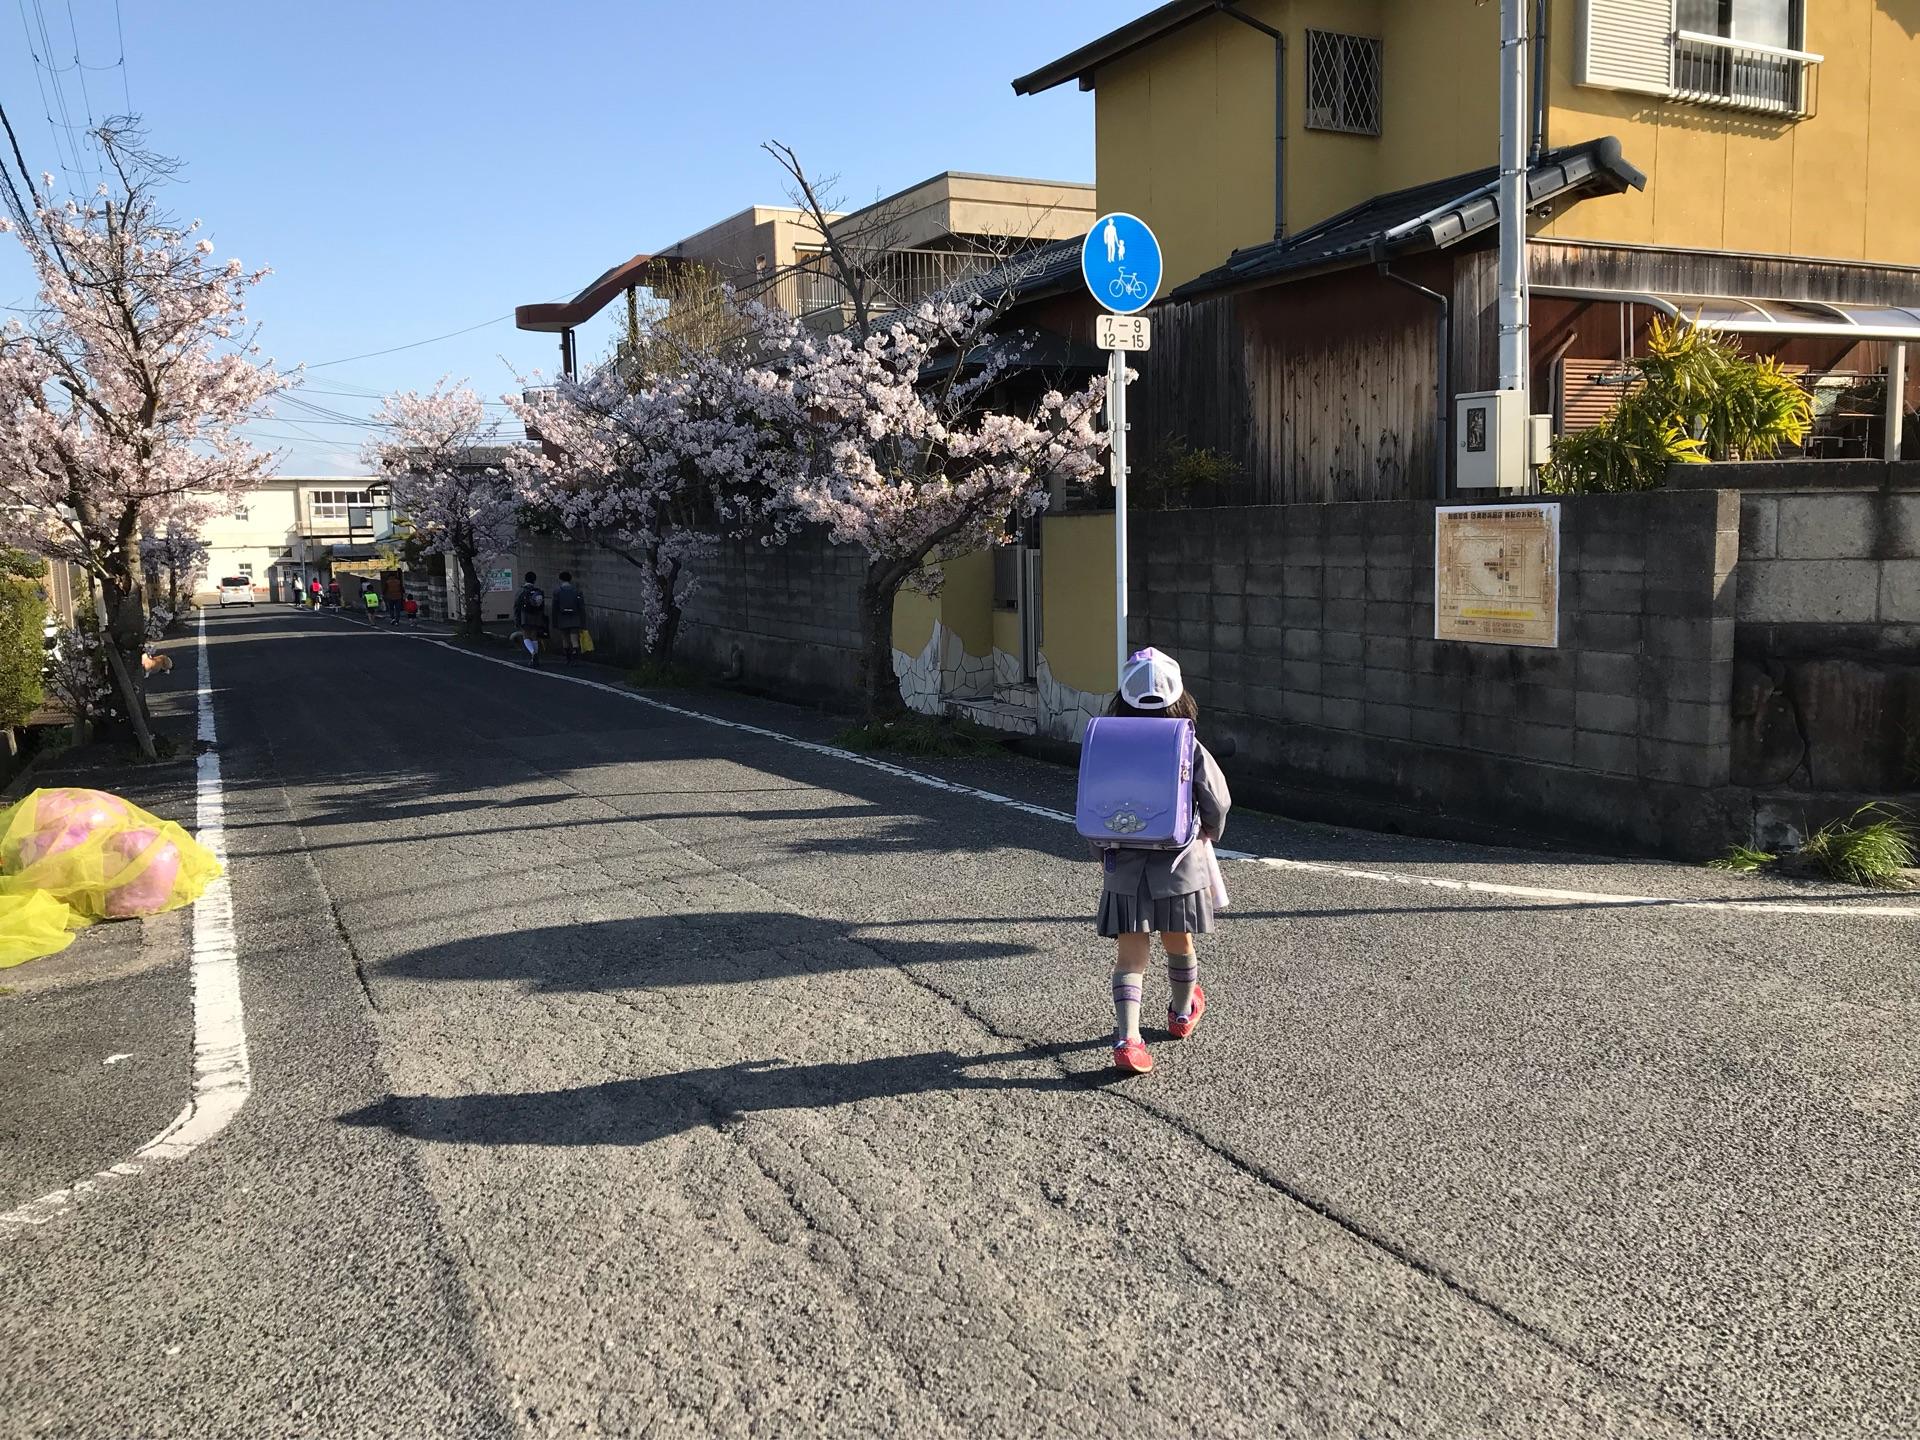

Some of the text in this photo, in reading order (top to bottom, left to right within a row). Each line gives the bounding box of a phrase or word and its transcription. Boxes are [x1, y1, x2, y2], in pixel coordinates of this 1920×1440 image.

[1106, 318, 1113, 332] 7
[1134, 319, 1141, 333] 9
[1104, 333, 1116, 347] 12
[1132, 334, 1144, 348] 15
